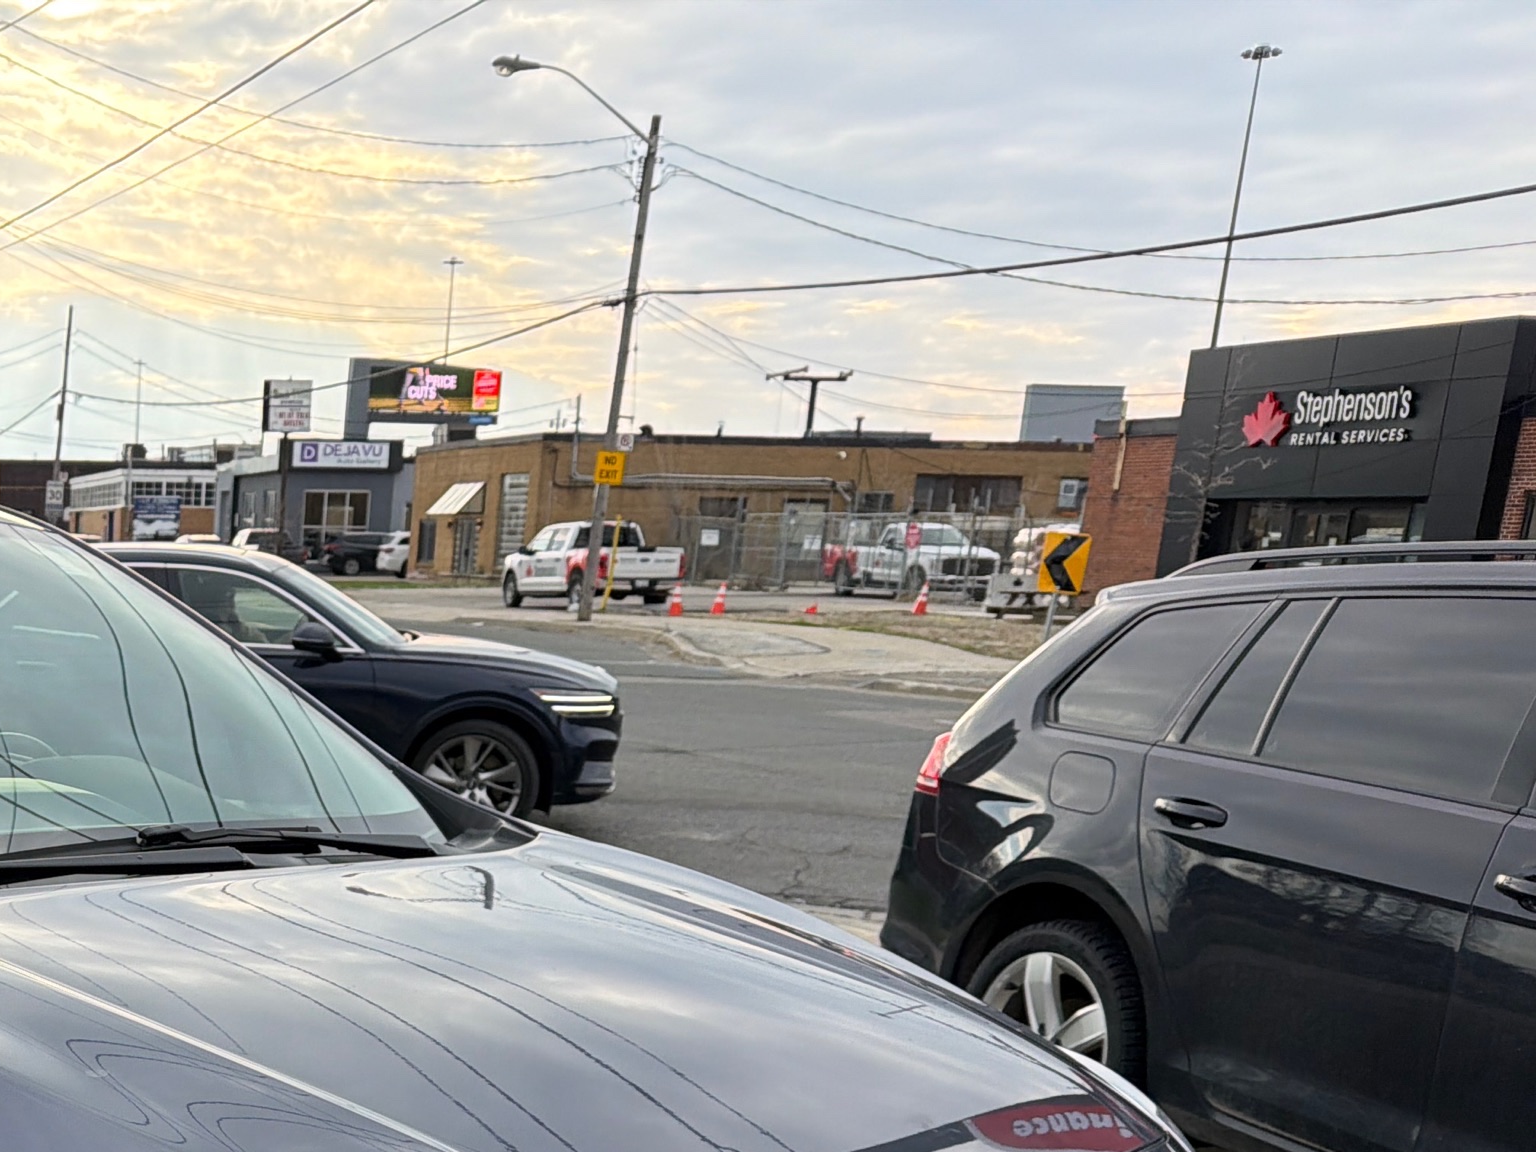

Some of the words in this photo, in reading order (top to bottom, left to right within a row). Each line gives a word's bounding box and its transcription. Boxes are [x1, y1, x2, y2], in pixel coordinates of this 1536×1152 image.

[426, 375, 457, 390] PRICE
[408, 385, 437, 400] CUTS
[1294, 385, 1412, 427] Stephenson's
[1290, 431, 1337, 446] RENTAL
[1341, 428, 1405, 444] SERVICES
[362, 444, 383, 457] VU
[604, 455, 618, 466] NO
[599, 469, 619, 479] EXIT
